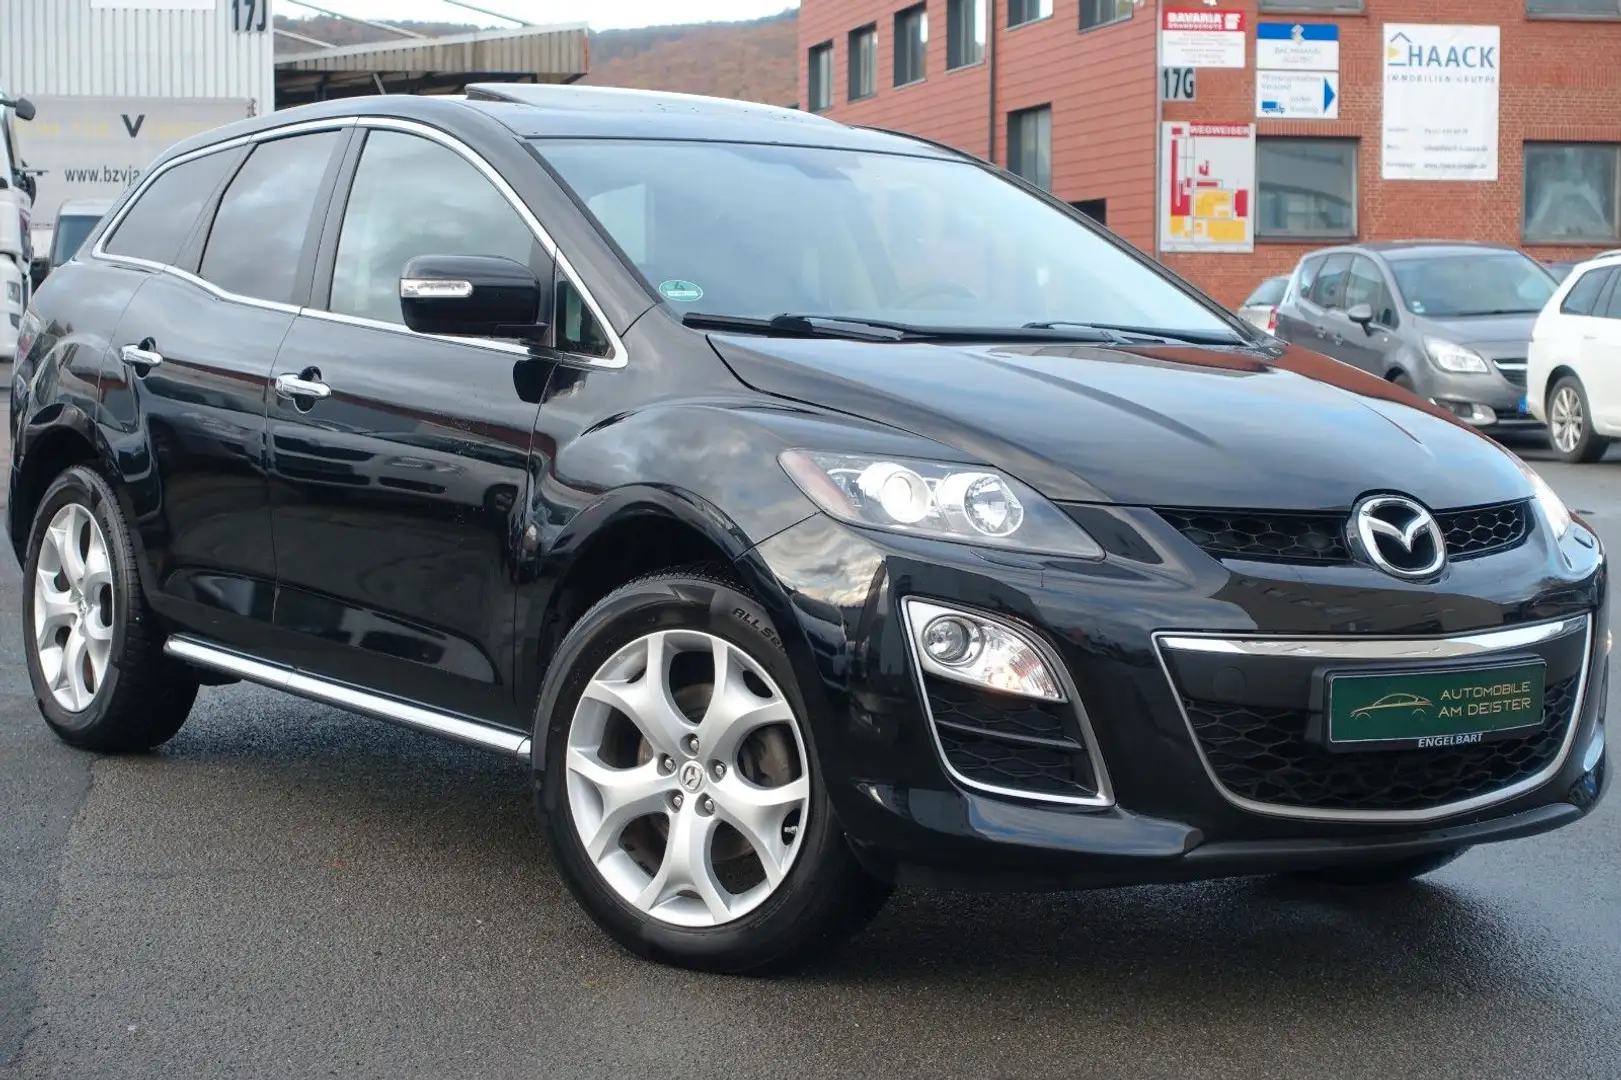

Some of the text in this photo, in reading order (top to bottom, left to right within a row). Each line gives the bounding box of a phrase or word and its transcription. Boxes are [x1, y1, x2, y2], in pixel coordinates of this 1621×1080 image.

[232, 0, 267, 31] 17J
[1408, 45, 1496, 68] HAACK
[1164, 68, 1194, 98] 17G
[732, 607, 760, 630] ALL
[1440, 681, 1531, 701] AUTOMOBILE
[1438, 697, 1531, 718] AM DEISTER
[1418, 733, 1483, 748] ENGELBART
